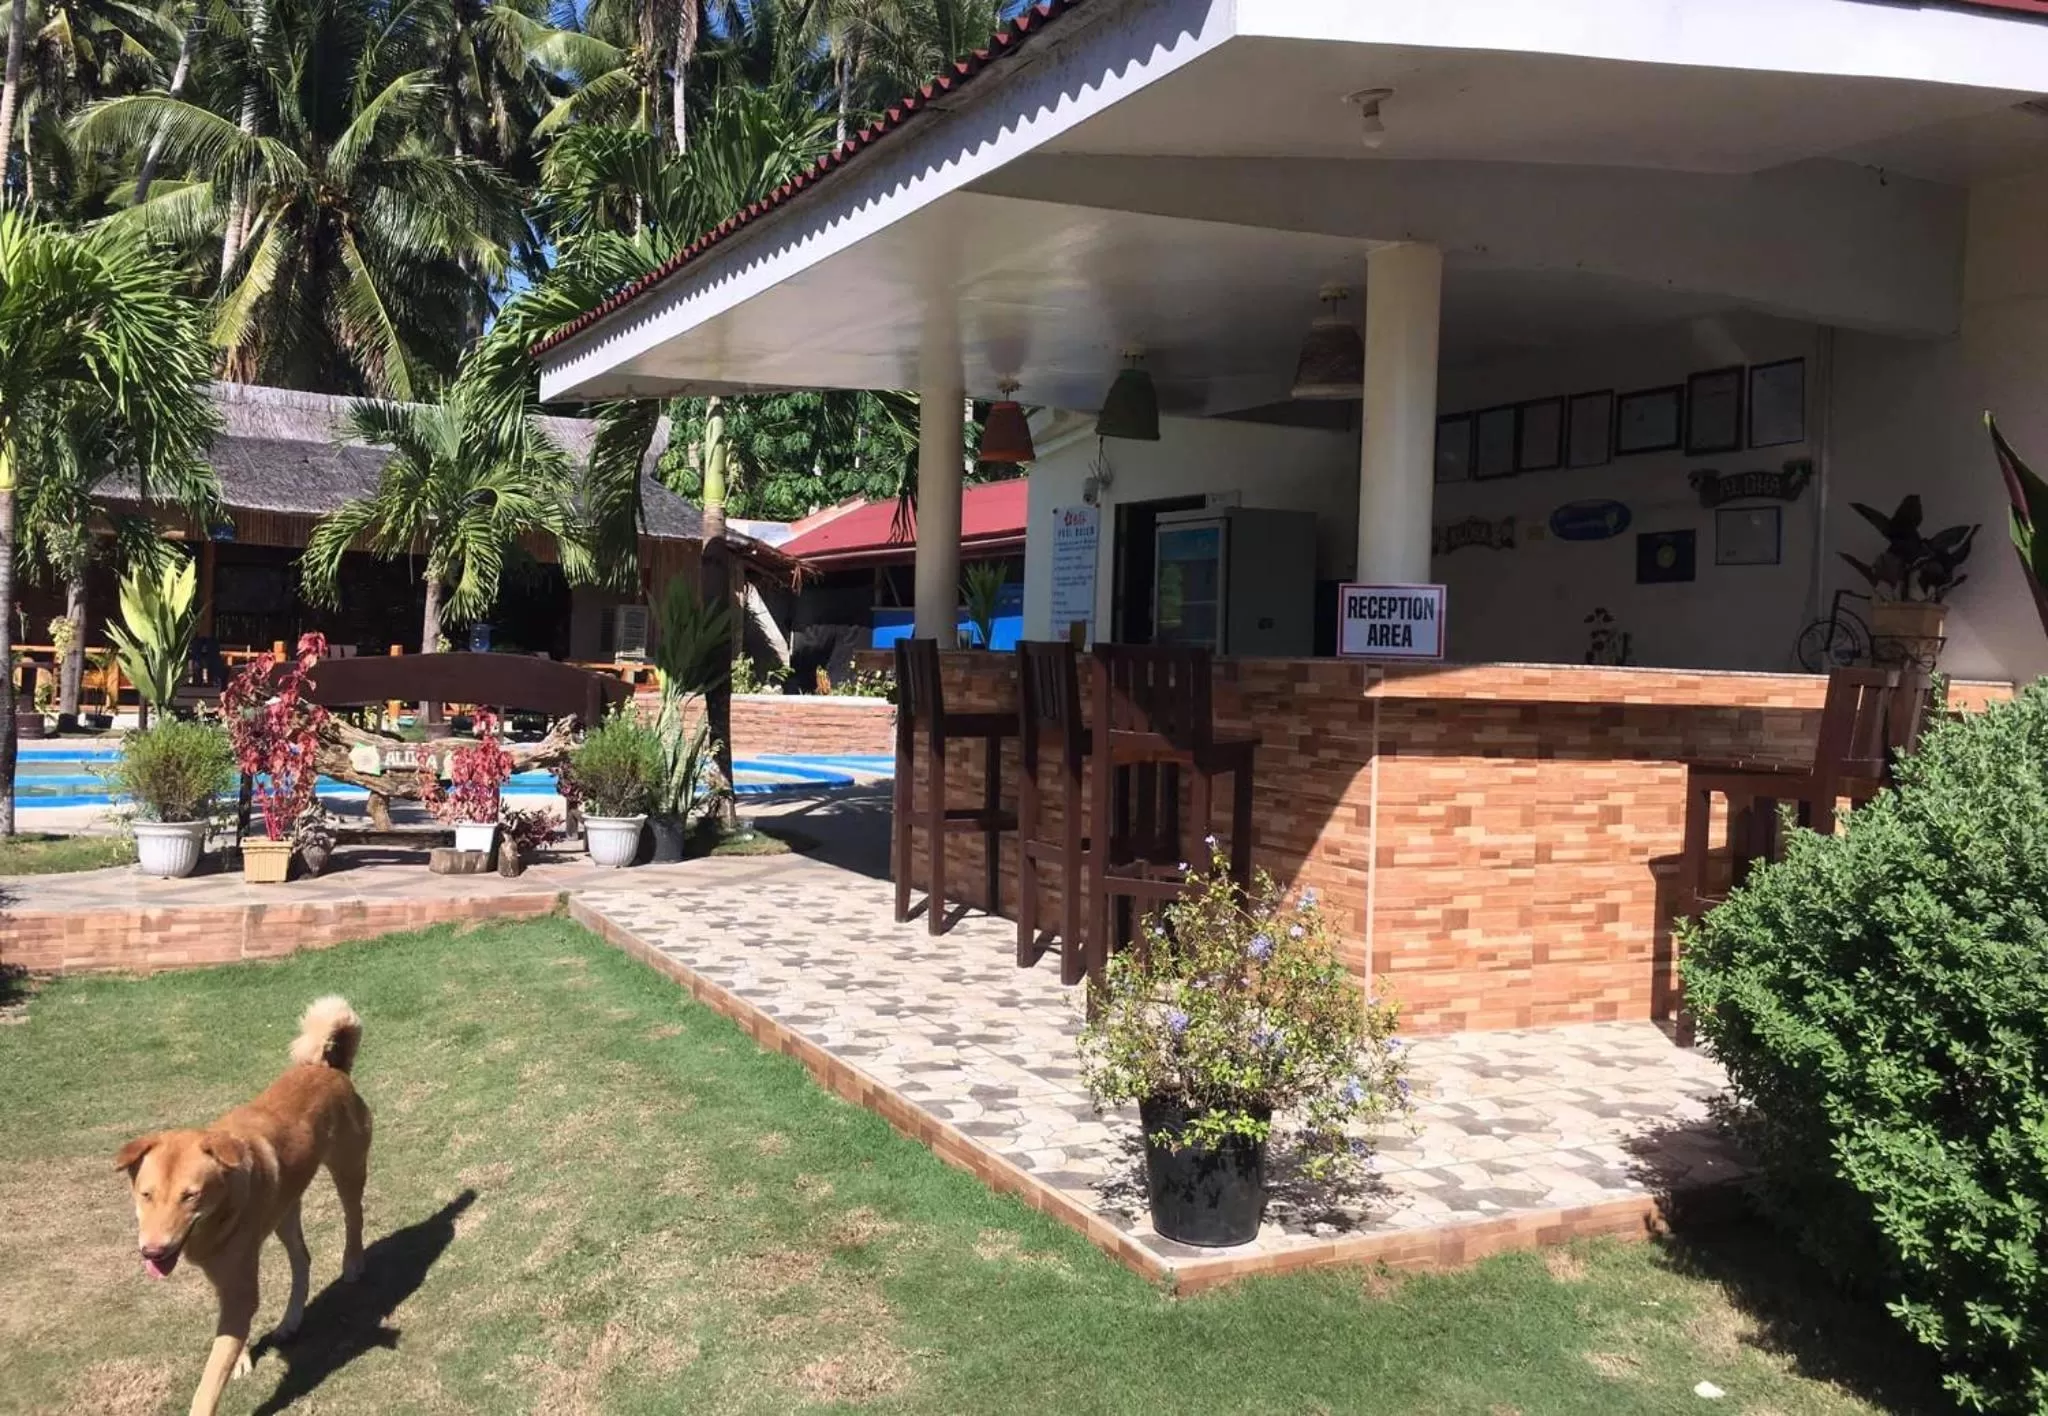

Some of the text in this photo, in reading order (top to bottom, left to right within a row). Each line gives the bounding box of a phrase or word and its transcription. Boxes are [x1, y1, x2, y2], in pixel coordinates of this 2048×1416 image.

[1721, 472, 1781, 500] ALOHA
[1347, 596, 1435, 620] RECEPTION
[1366, 623, 1413, 647] AREA
[384, 751, 438, 770] ALOA
